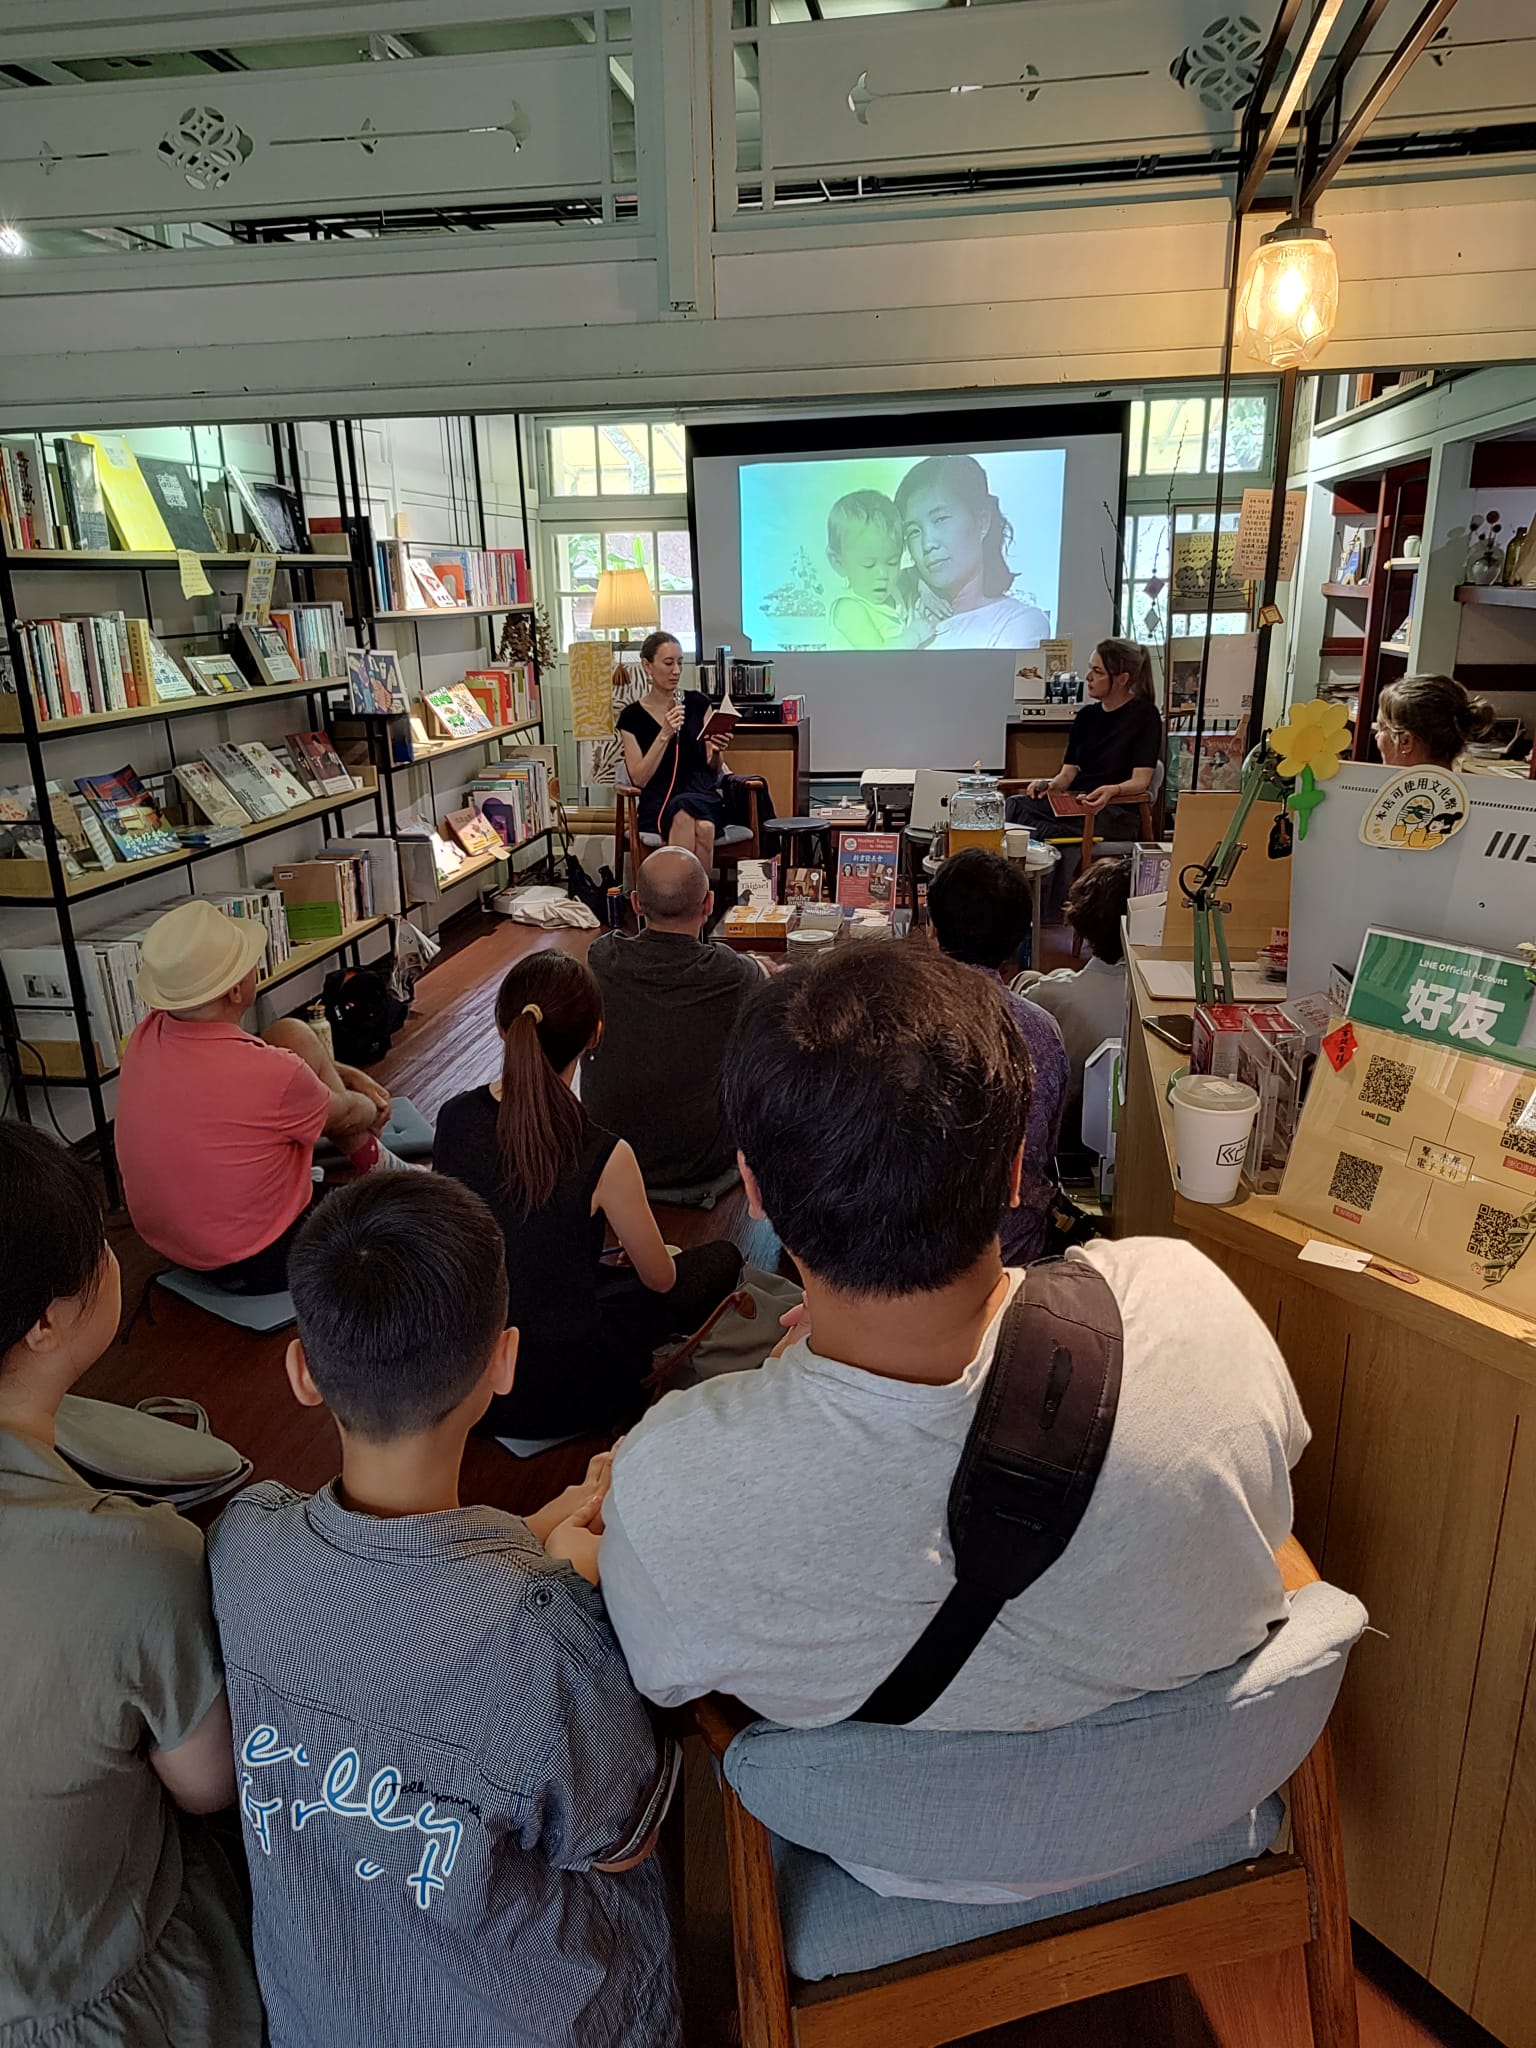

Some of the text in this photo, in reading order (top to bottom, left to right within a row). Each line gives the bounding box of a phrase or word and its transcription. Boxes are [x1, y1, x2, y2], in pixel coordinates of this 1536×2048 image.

[1375, 778, 1459, 821] 本店可使用文化幣
[1418, 958, 1508, 986] LINE Official Account
[1402, 978, 1505, 1046] 好友
[1361, 1110, 1376, 1121] LINE
